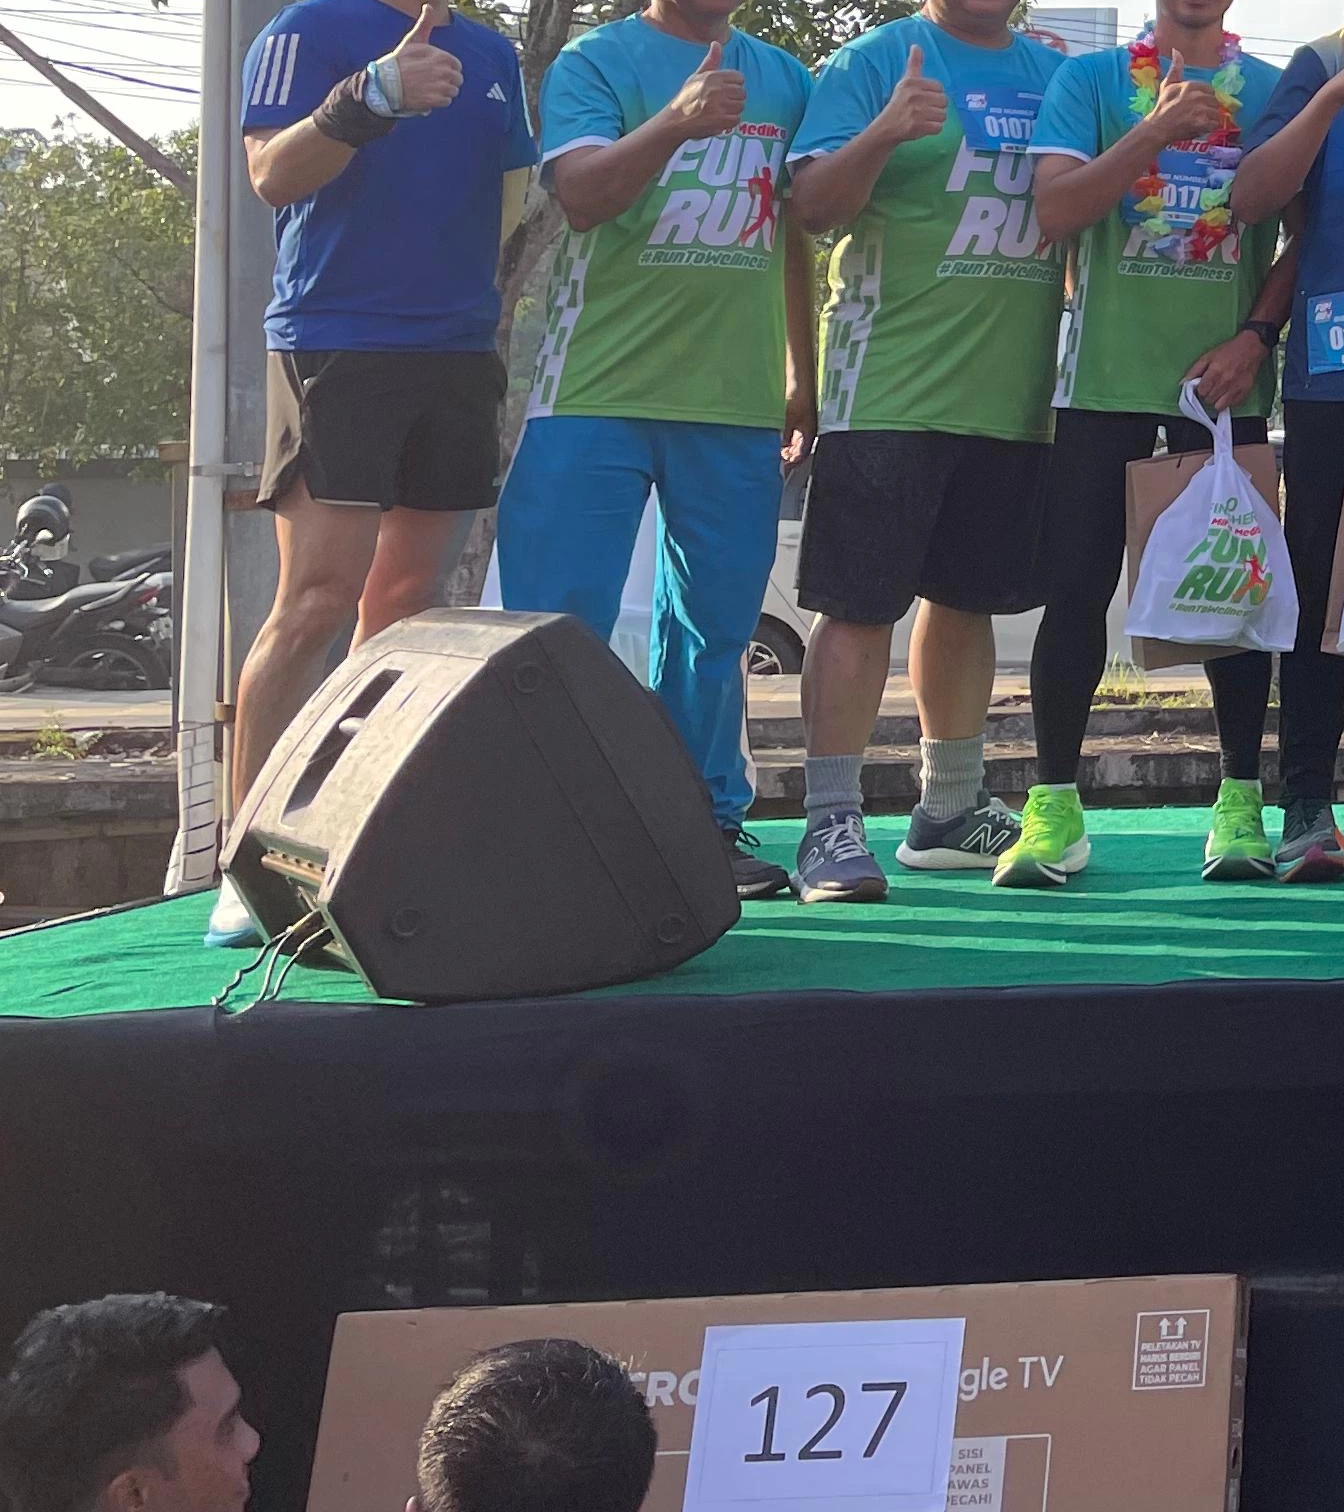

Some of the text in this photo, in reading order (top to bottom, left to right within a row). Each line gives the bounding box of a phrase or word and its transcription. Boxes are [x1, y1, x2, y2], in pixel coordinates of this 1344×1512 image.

[985, 115, 1033, 141] 0107
[657, 135, 785, 187] FUN
[648, 189, 780, 252] RUN
[1173, 565, 1272, 606] RUN
[1190, 1340, 1202, 1350] TV
[960, 1356, 1008, 1402] gle
[1018, 1355, 1065, 1389] TV
[1140, 1362, 1200, 1374] AGAR PANEL
[1140, 1372, 1200, 1385] TIDAK PECAH
[743, 1381, 909, 1464] 127
[958, 1447, 983, 1460] SISI
[947, 1478, 990, 1490] AWAS
